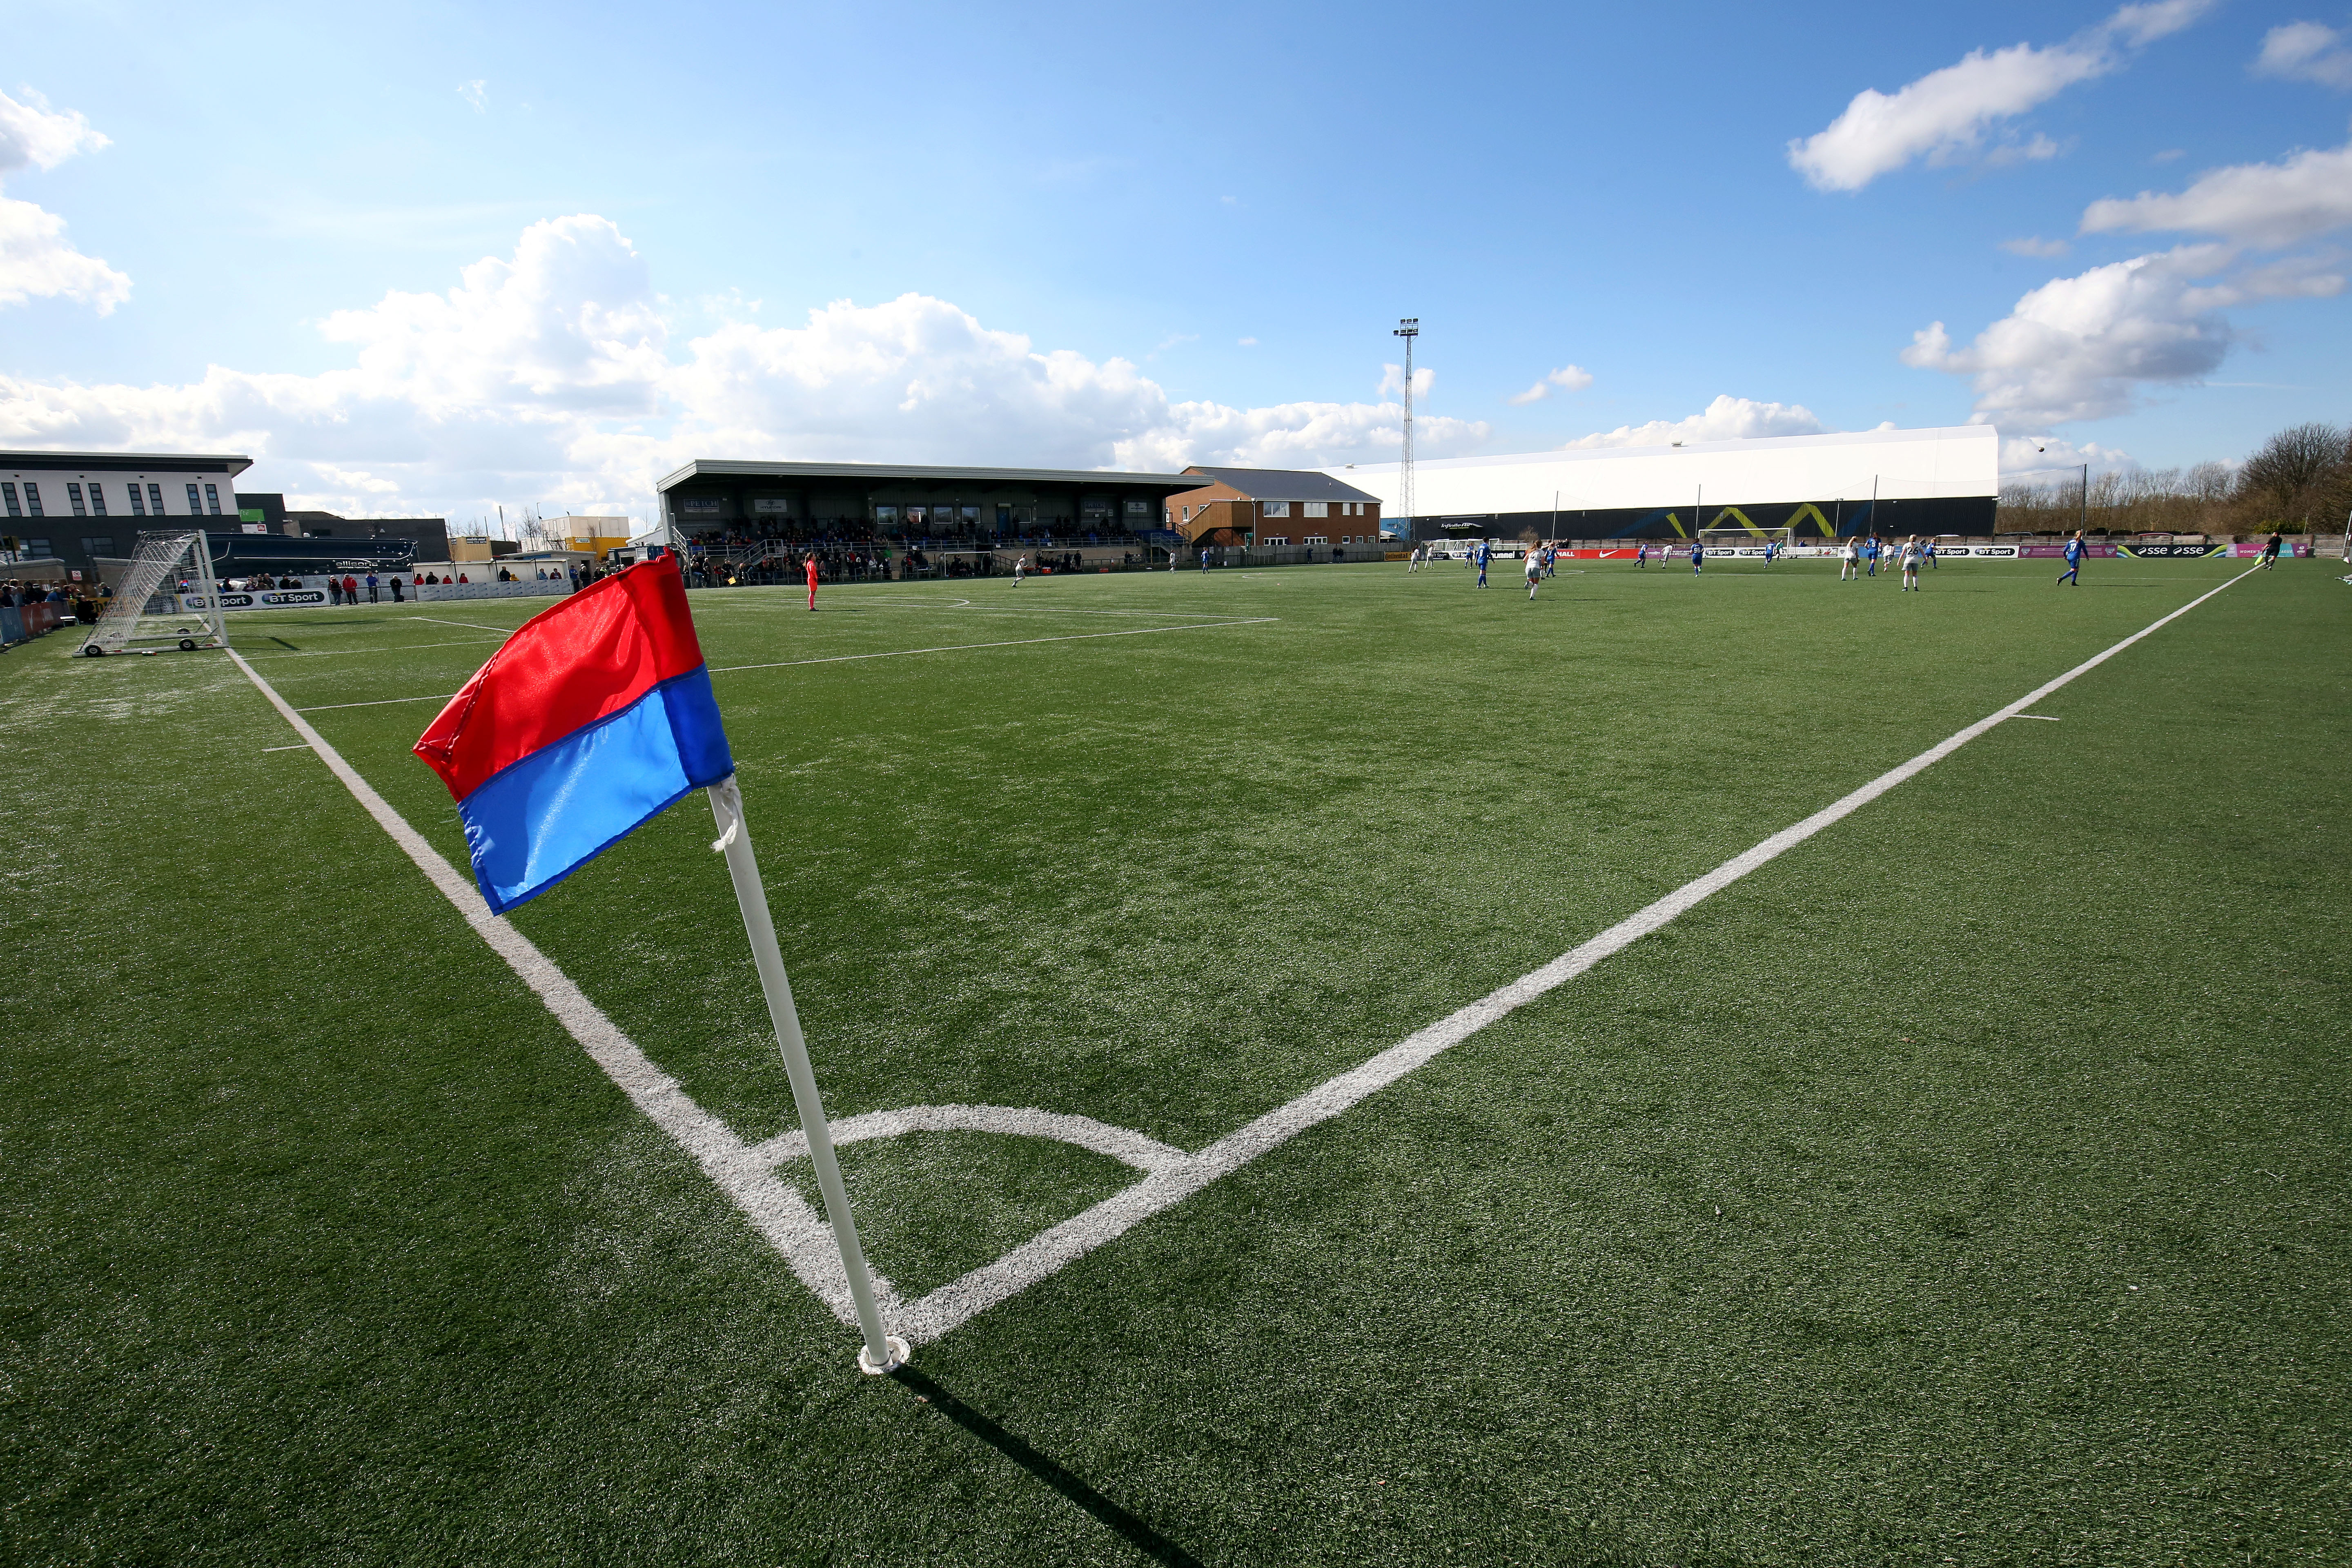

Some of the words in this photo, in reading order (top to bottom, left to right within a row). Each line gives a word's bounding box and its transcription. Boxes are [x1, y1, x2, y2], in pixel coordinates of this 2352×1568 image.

[1908, 546, 1918, 555] 26
[2070, 543, 2077, 552] 17
[289, 593, 318, 603] Sport
